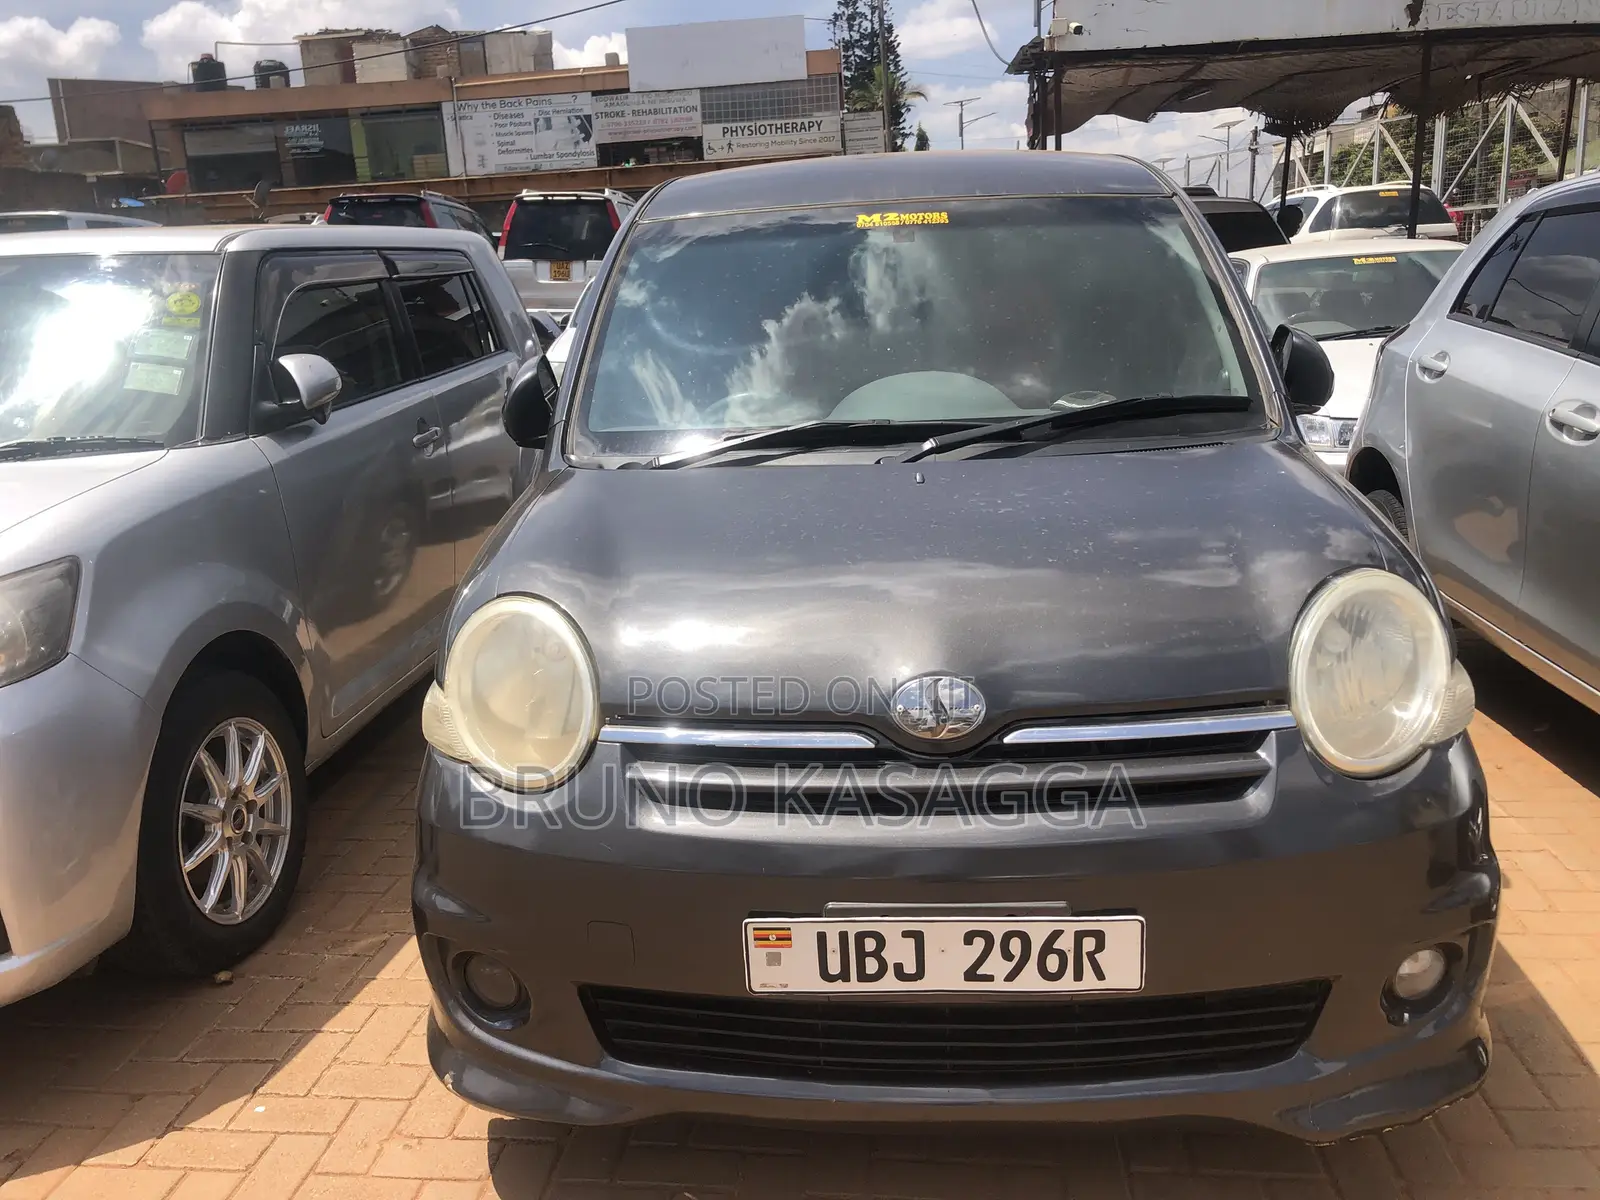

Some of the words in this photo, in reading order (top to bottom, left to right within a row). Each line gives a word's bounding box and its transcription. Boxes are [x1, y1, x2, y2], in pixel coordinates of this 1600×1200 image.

[457, 101, 478, 112] Why
[482, 99, 498, 109] the
[499, 98, 522, 108] Back
[493, 111, 525, 120] Diseases
[594, 110, 626, 120] STROKE
[631, 105, 698, 117] REHABILITATION
[736, 141, 769, 150] Restoring
[771, 138, 798, 147] Mobility
[799, 137, 818, 145] Since
[530, 152, 554, 161] Lumbar
[556, 150, 596, 160] Spondylosis
[900, 211, 948, 221] MOTORS
[816, 929, 926, 983] UBJ
[962, 929, 1107, 983] 296R
